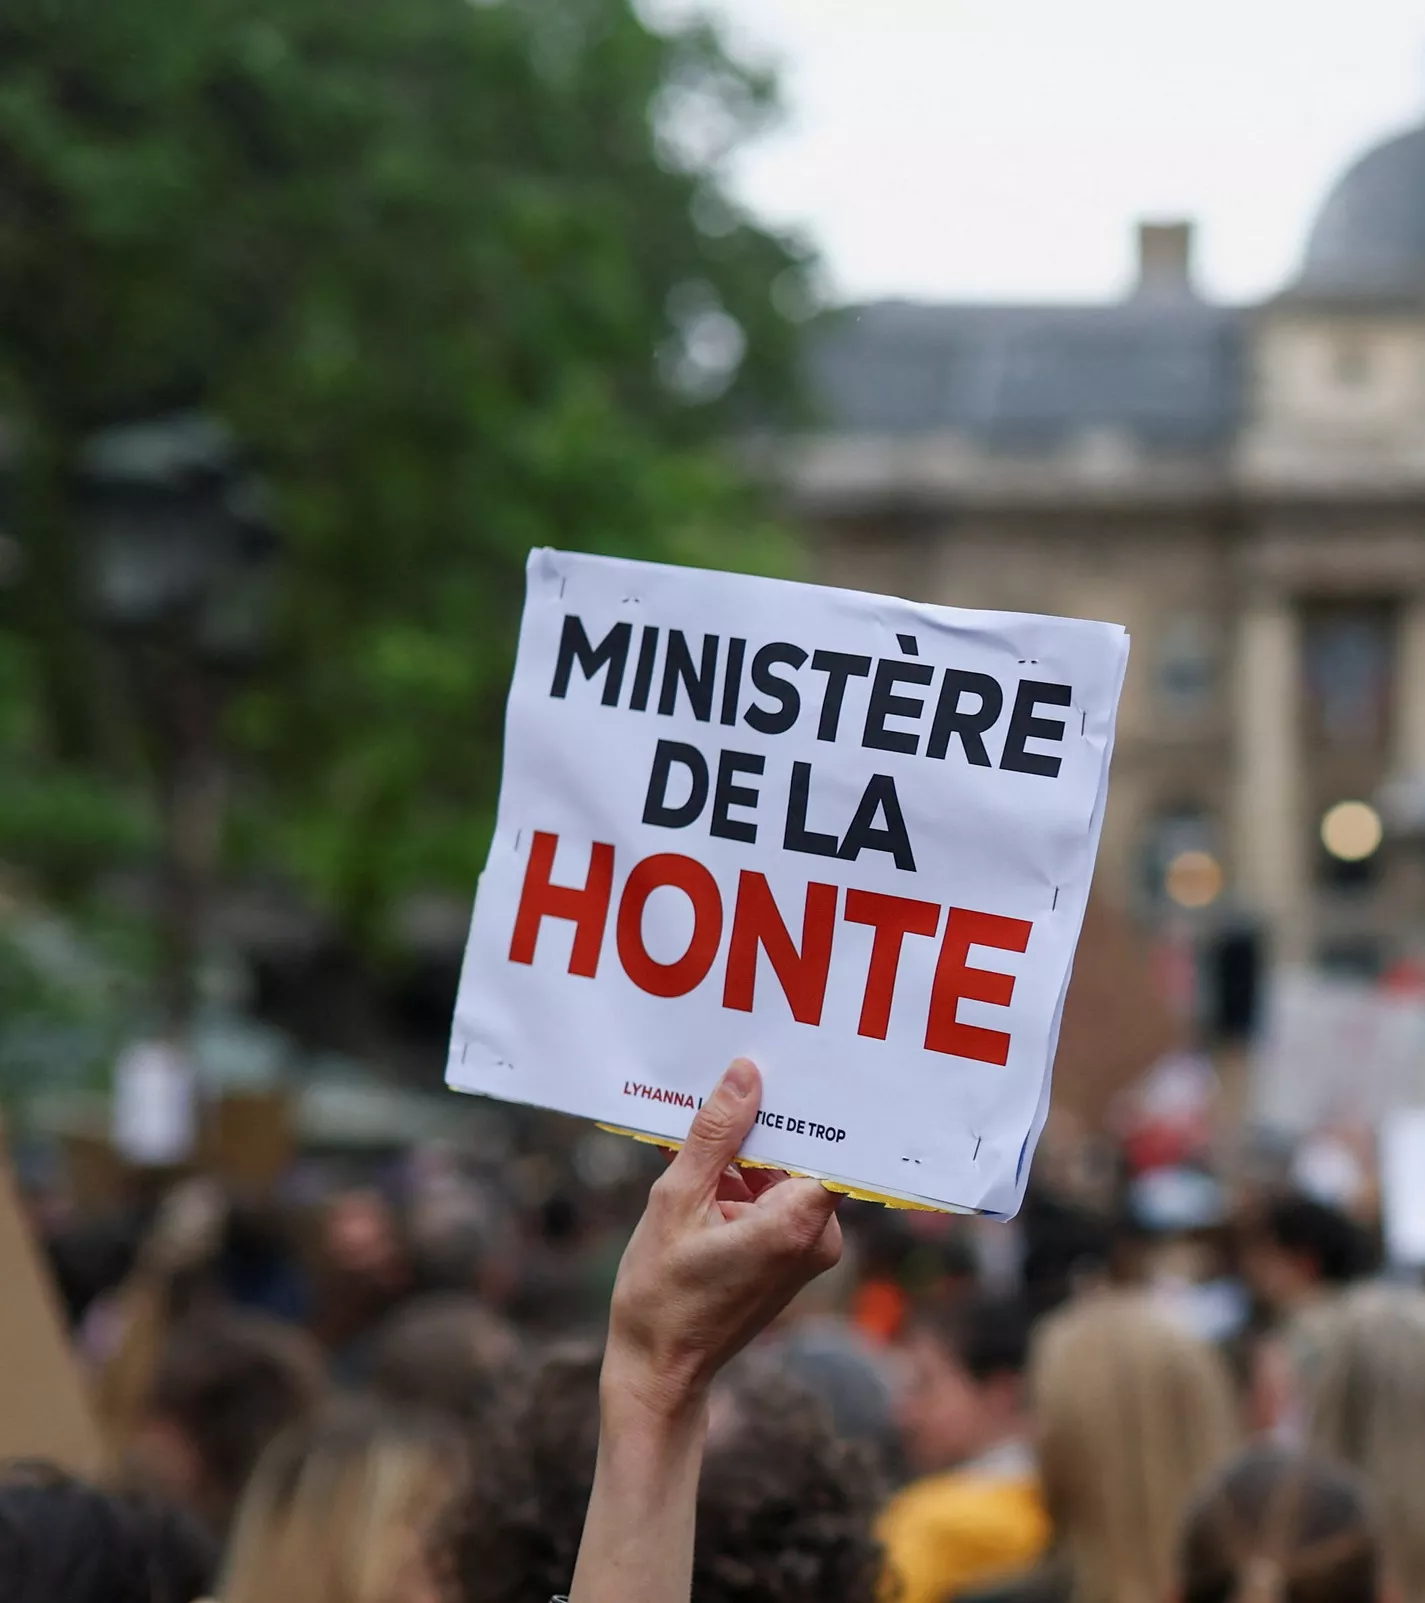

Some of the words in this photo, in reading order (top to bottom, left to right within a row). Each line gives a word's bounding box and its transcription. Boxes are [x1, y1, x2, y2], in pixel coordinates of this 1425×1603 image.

[549, 614, 1073, 778] MINISTÈRE
[641, 738, 766, 844] DE
[782, 760, 917, 873] LA
[507, 829, 1034, 1067] HONTE
[623, 1081, 694, 1109] LYHANNA
[786, 1117, 805, 1135] DE
[808, 1122, 847, 1144] TROP
